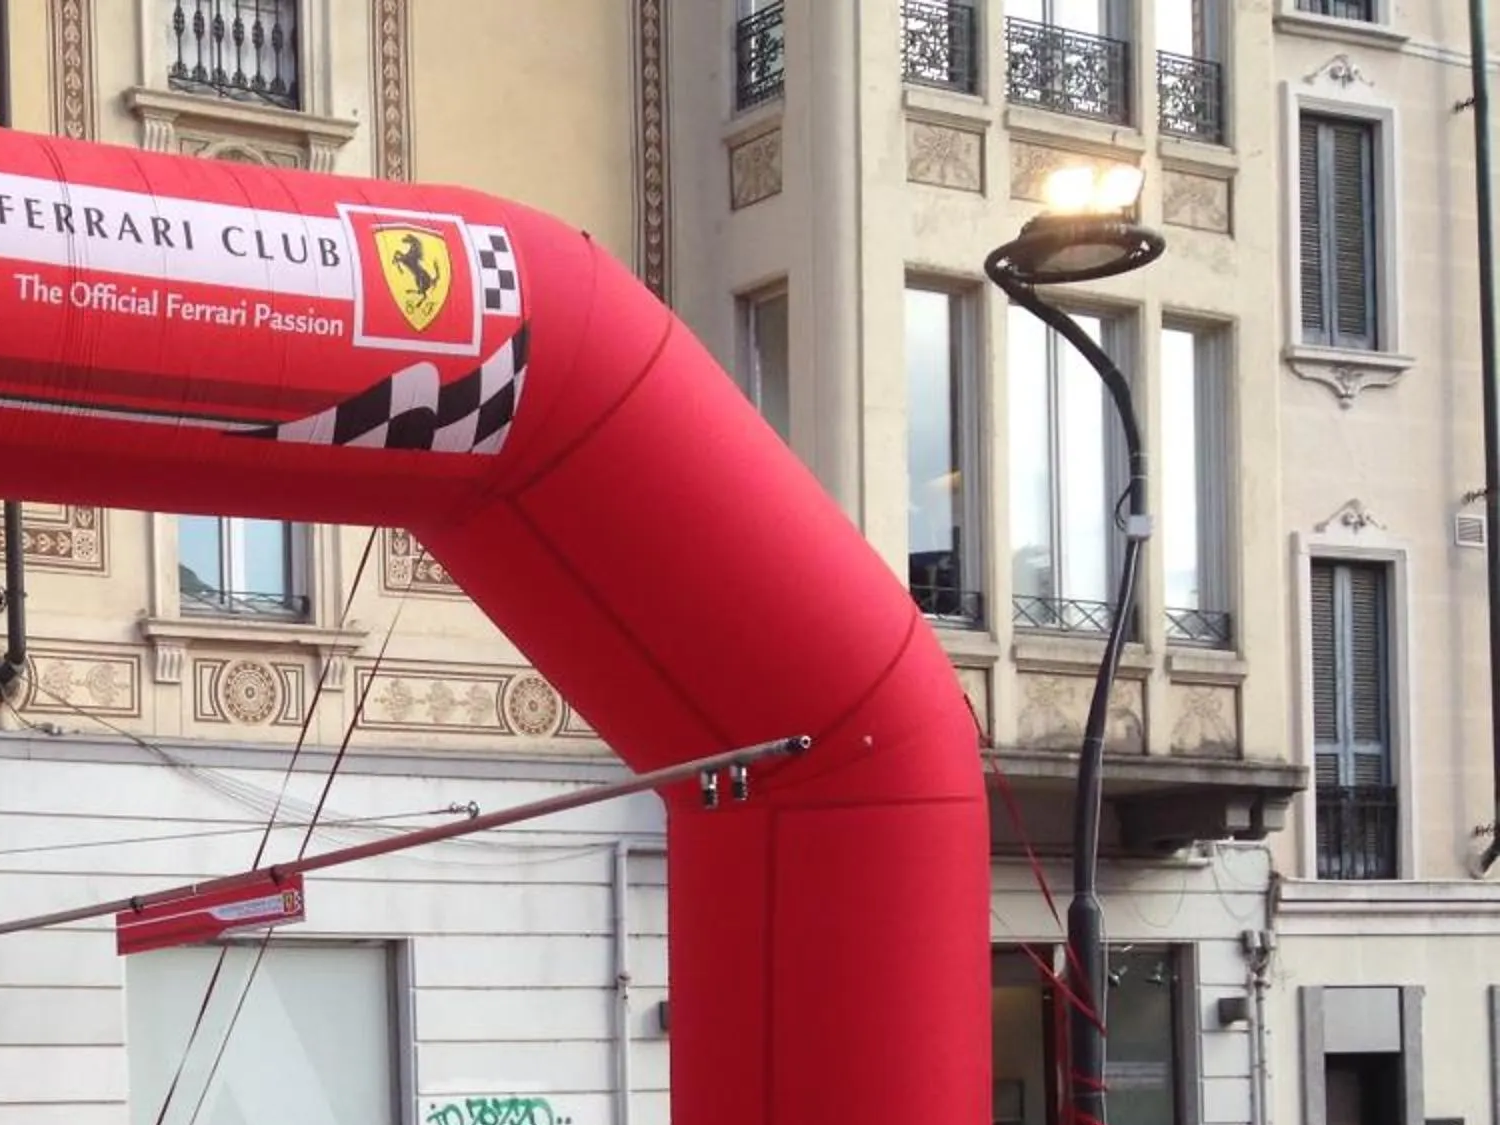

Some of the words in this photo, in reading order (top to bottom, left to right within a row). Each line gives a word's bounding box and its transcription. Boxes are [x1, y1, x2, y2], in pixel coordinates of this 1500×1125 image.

[221, 225, 341, 268] CLUB
[14, 272, 63, 305] The
[70, 281, 159, 317] Official
[166, 293, 247, 327] Ferrari
[254, 303, 344, 337] Passion
